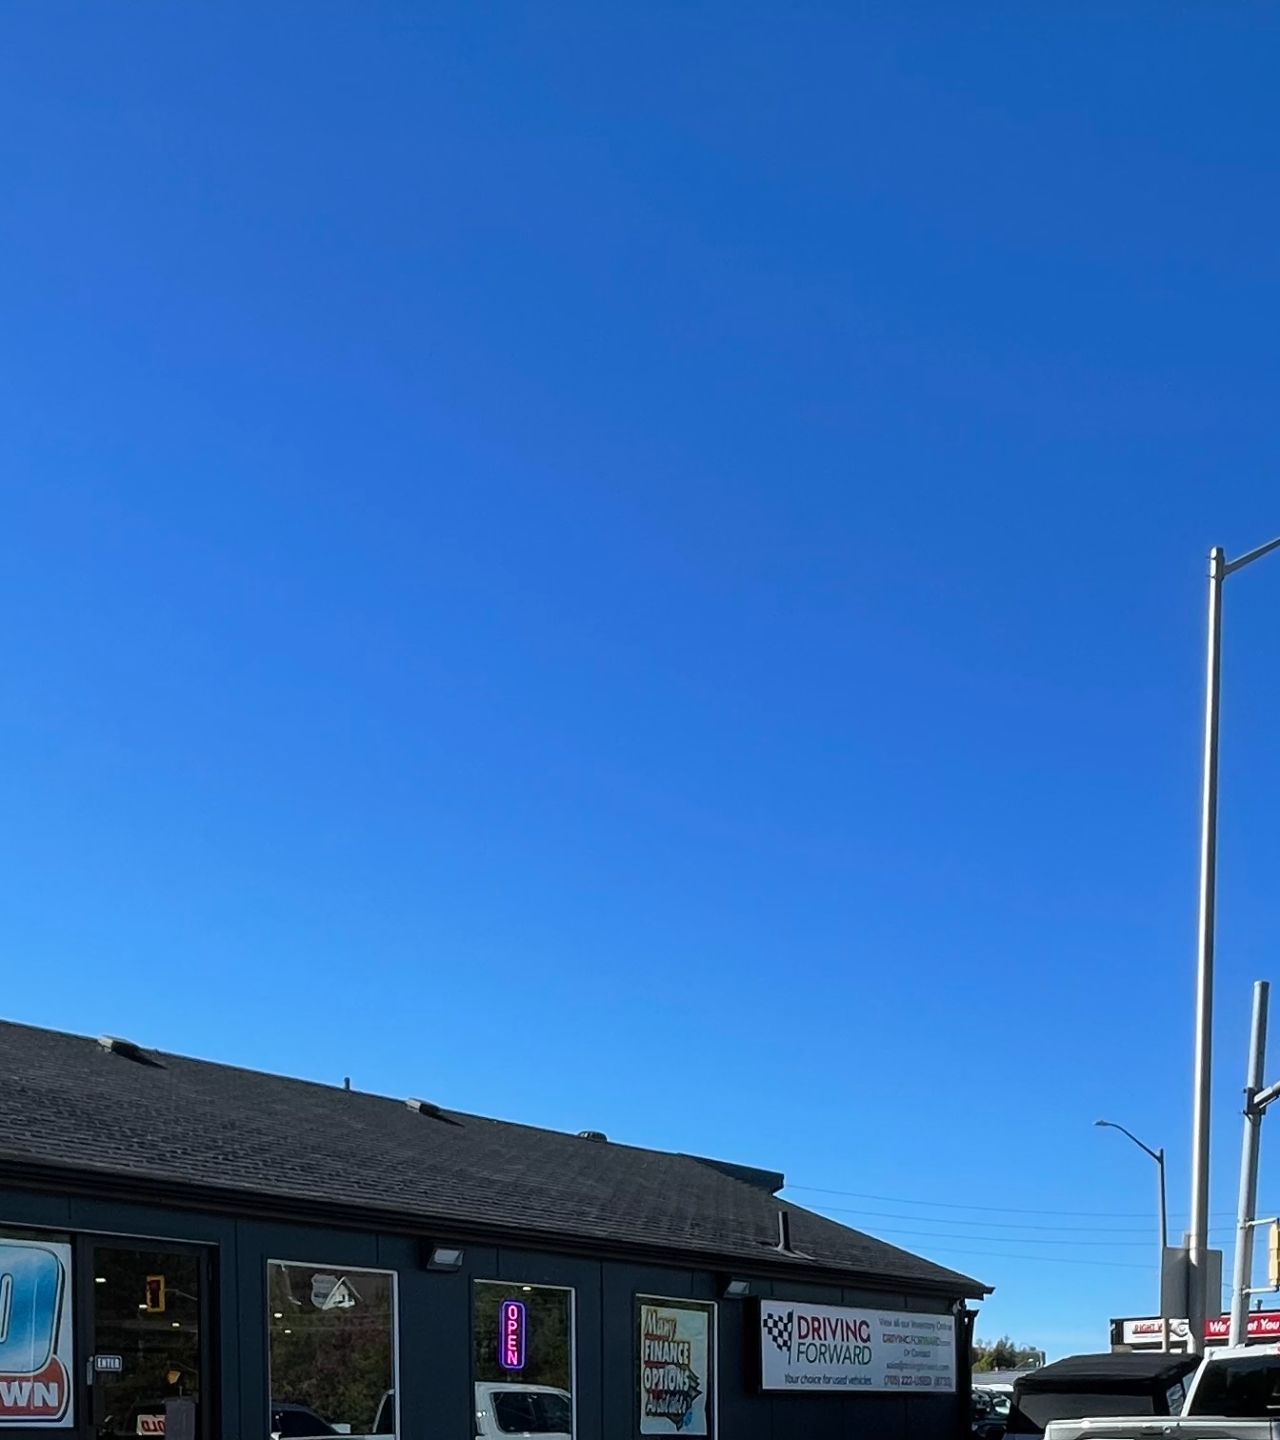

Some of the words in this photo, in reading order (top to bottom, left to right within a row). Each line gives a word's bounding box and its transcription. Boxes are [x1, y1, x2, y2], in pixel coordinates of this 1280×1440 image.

[508, 1305, 518, 1365] OPEN
[797, 1315, 872, 1344] DRIVING
[1260, 1318, 1280, 1330] You
[97, 1357, 121, 1369] ENTER
[645, 1340, 689, 1364] FINANCE
[797, 1342, 872, 1366] FORWARD
[644, 1366, 690, 1391] OPTIONS
[784, 1373, 800, 1384] Your
[801, 1374, 821, 1385] choice
[822, 1374, 832, 1385] for
